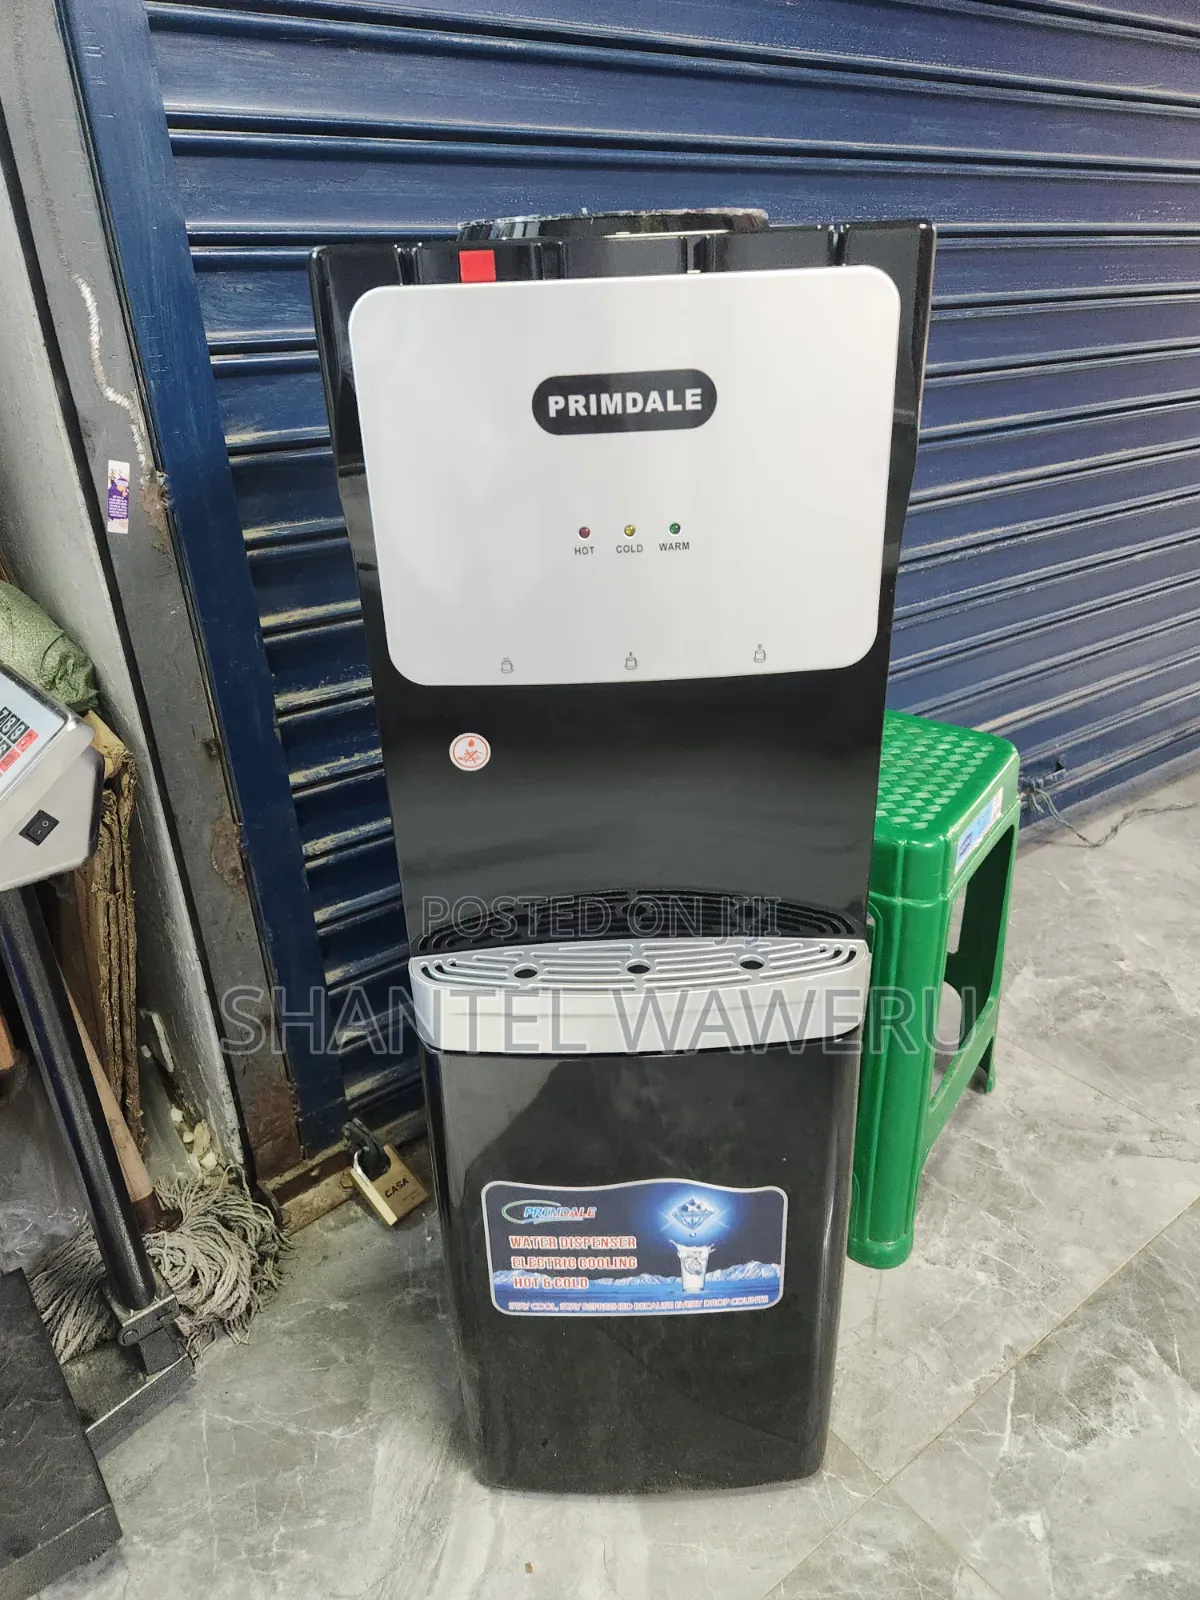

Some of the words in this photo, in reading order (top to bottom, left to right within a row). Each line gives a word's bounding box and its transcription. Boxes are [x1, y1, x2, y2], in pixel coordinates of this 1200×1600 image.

[548, 388, 702, 417] PRIMDALE
[574, 546, 594, 555] HOT
[616, 544, 643, 554] COLD
[659, 541, 690, 552] WARM
[2, 717, 16, 734] 8
[10, 724, 25, 740] 9
[385, 1178, 409, 1198] CASA
[523, 1206, 598, 1219] PRIMDALE
[509, 1236, 558, 1249] WATER
[559, 1236, 637, 1249] DISPENSER
[511, 1256, 576, 1270] ELECTRIC
[578, 1256, 638, 1270] COOLING
[513, 1277, 540, 1289] HOT
[543, 1278, 552, 1289] &
[554, 1277, 589, 1289] COLD
[704, 1298, 730, 1307] DROP
